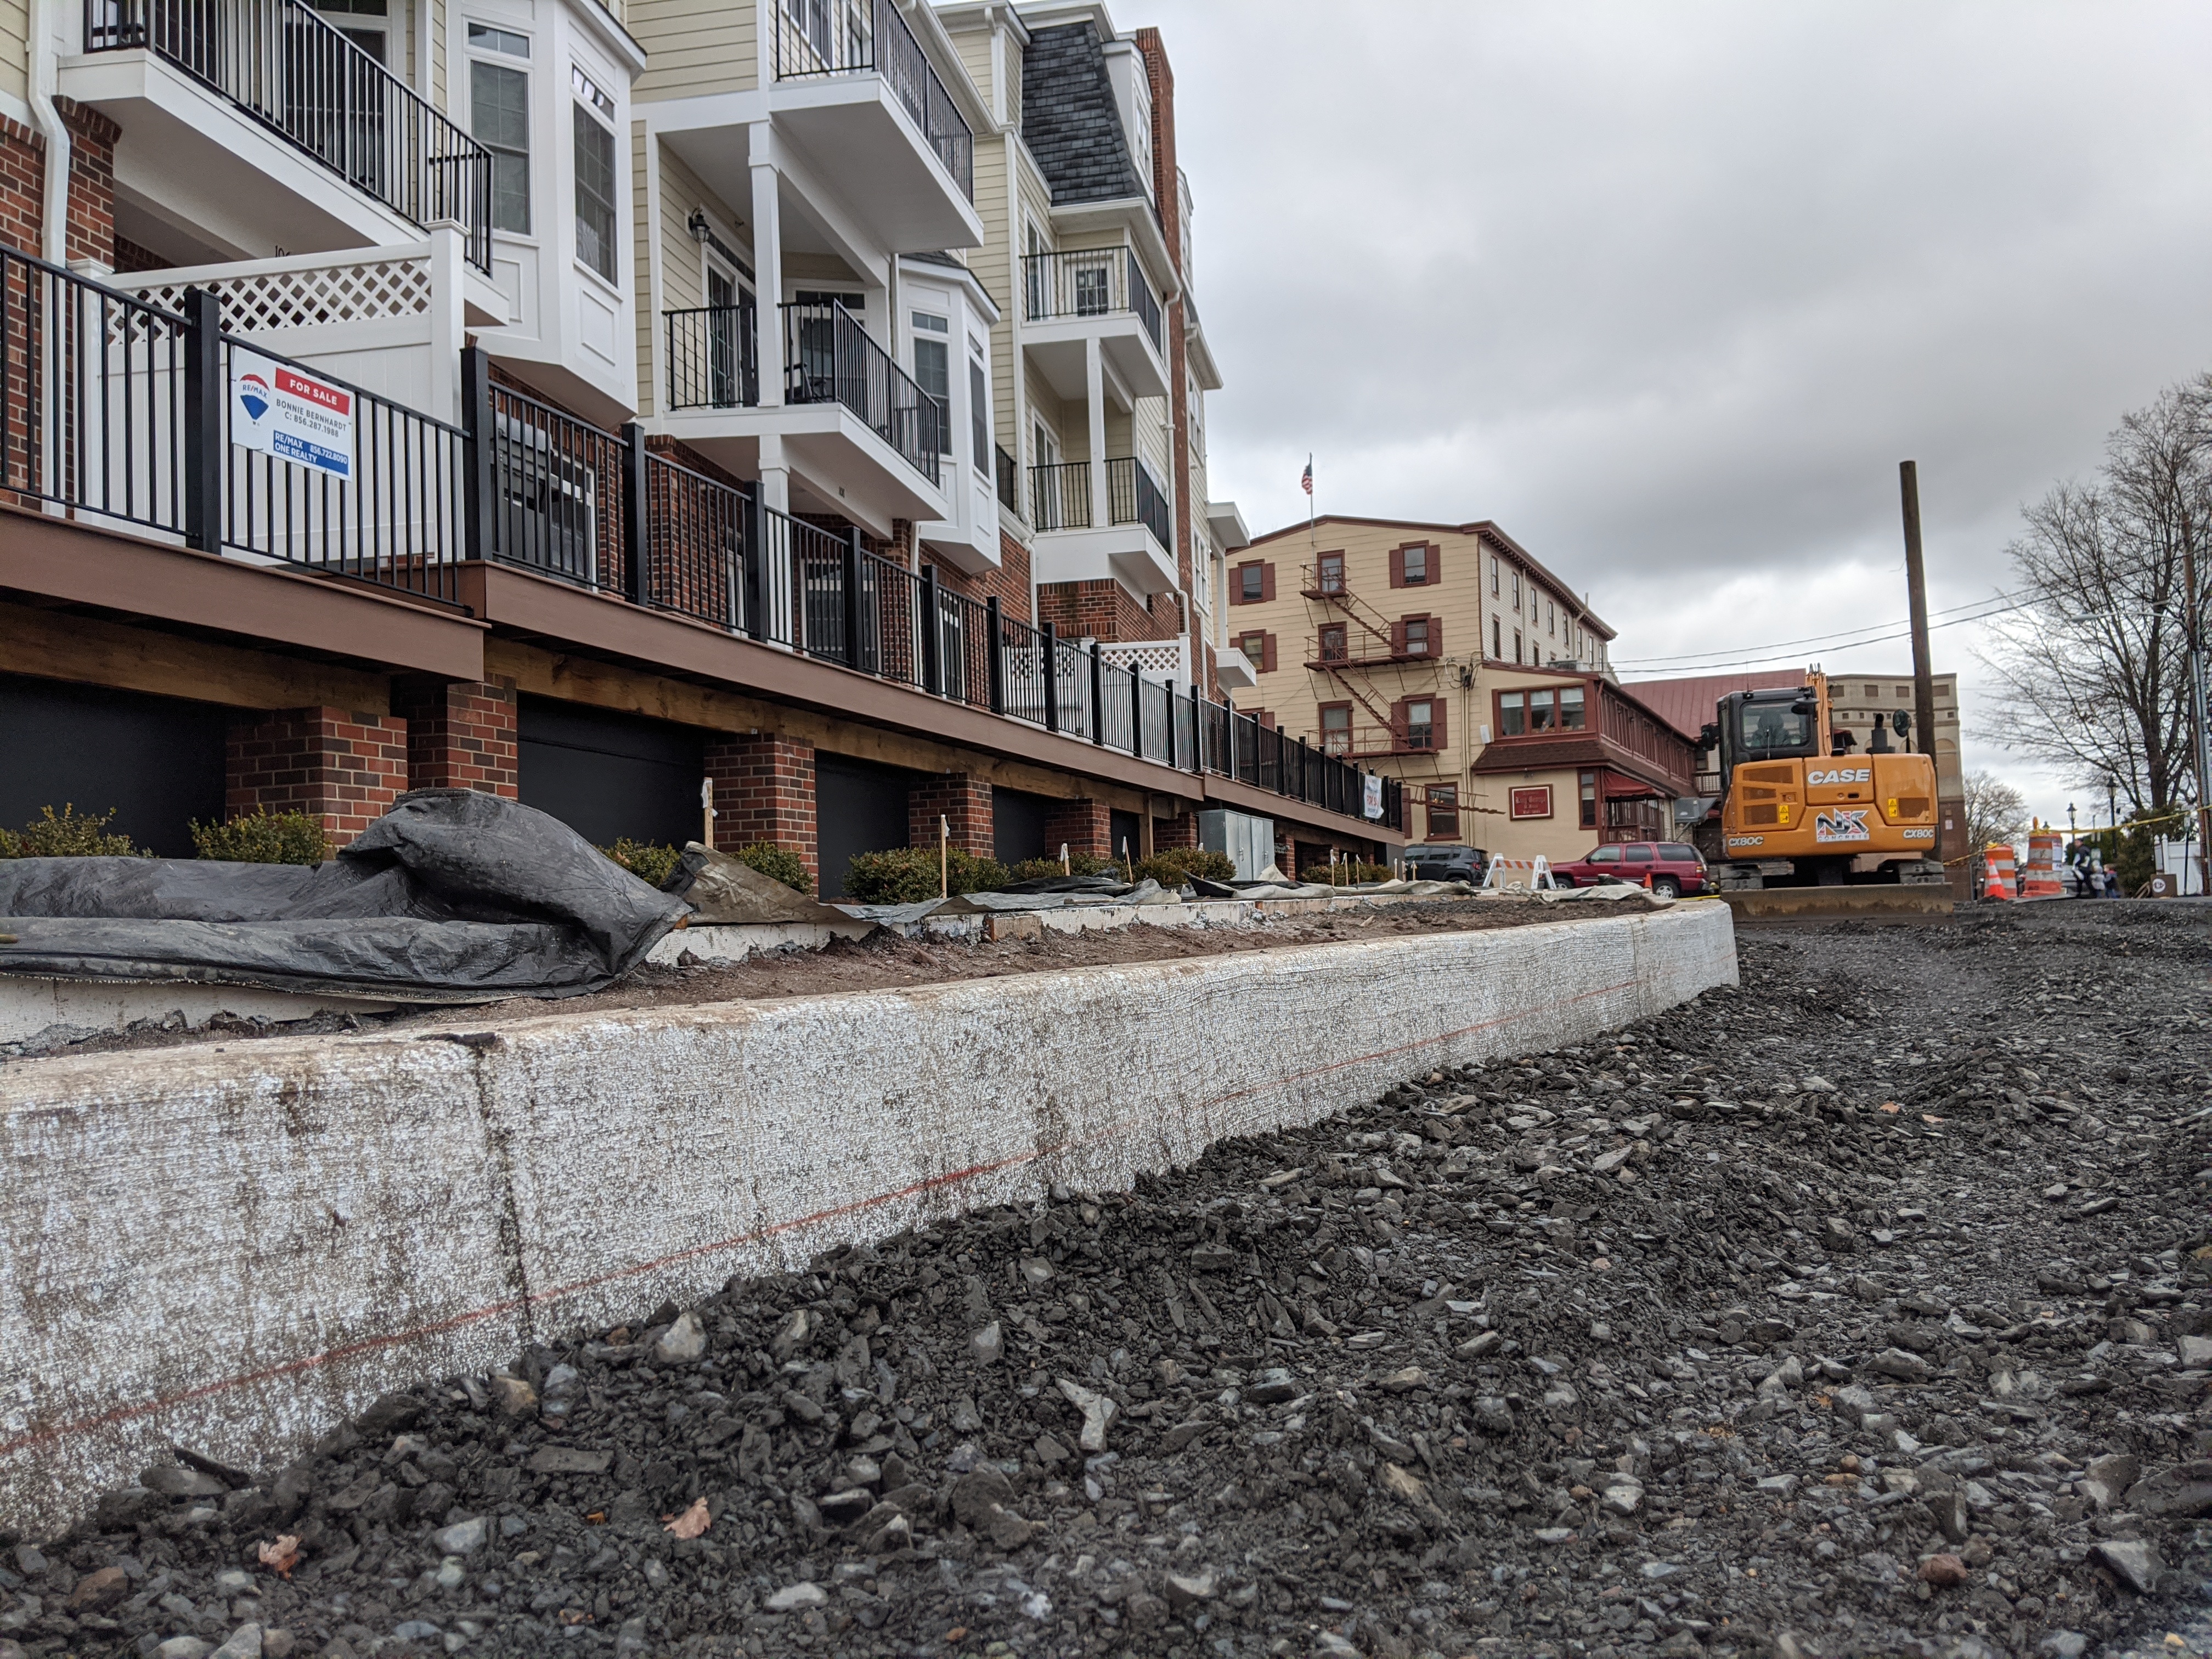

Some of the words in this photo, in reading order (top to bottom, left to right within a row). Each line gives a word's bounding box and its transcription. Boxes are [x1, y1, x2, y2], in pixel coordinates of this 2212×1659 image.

[242, 384, 267, 399] RE/MAX
[290, 379, 310, 395] FOR
[313, 388, 337, 405] SALE
[276, 398, 304, 415] BONNIE
[306, 409, 346, 432] BERNHARDT
[285, 411, 292, 421] C:
[294, 414, 339, 438] 856.287.1988
[275, 432, 303, 449] RE/MAX
[275, 442, 290, 456] ONE
[291, 447, 317, 463] REALTY
[310, 445, 347, 465] 856.722.8090
[1807, 768, 1871, 785] CASE
[1728, 836, 1764, 847] CX80C
[1903, 828, 1934, 839] CX80C
